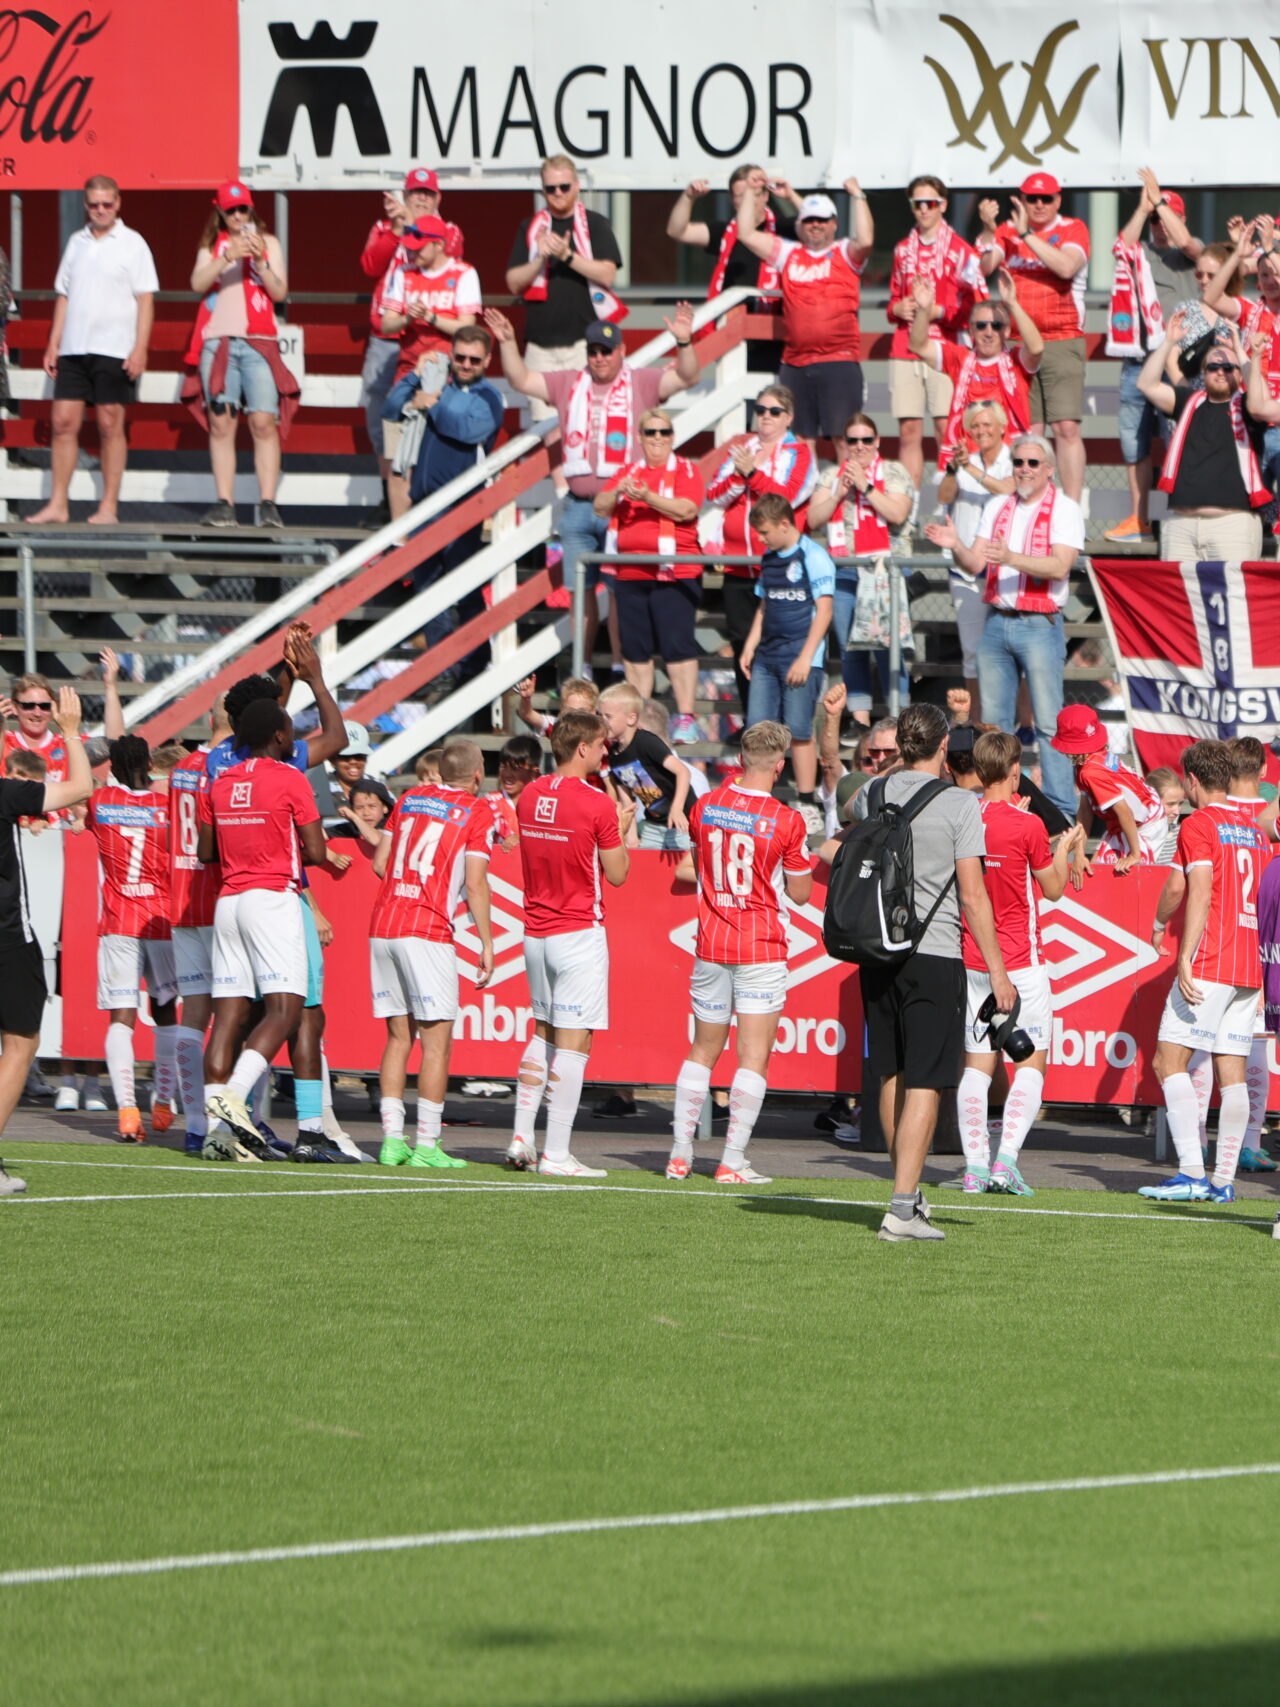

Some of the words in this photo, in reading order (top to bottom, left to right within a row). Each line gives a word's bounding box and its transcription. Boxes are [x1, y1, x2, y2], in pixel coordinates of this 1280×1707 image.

[410, 63, 814, 159] MAGNOR
[180, 793, 200, 855] 8
[404, 797, 449, 811] SpareBank
[703, 805, 754, 824] SpareBank
[120, 827, 146, 883] 7
[392, 817, 446, 884] 14
[708, 828, 756, 896] 18
[1237, 848, 1256, 915] 2
[453, 994, 534, 1042] mbr
[688, 1013, 846, 1056] bro
